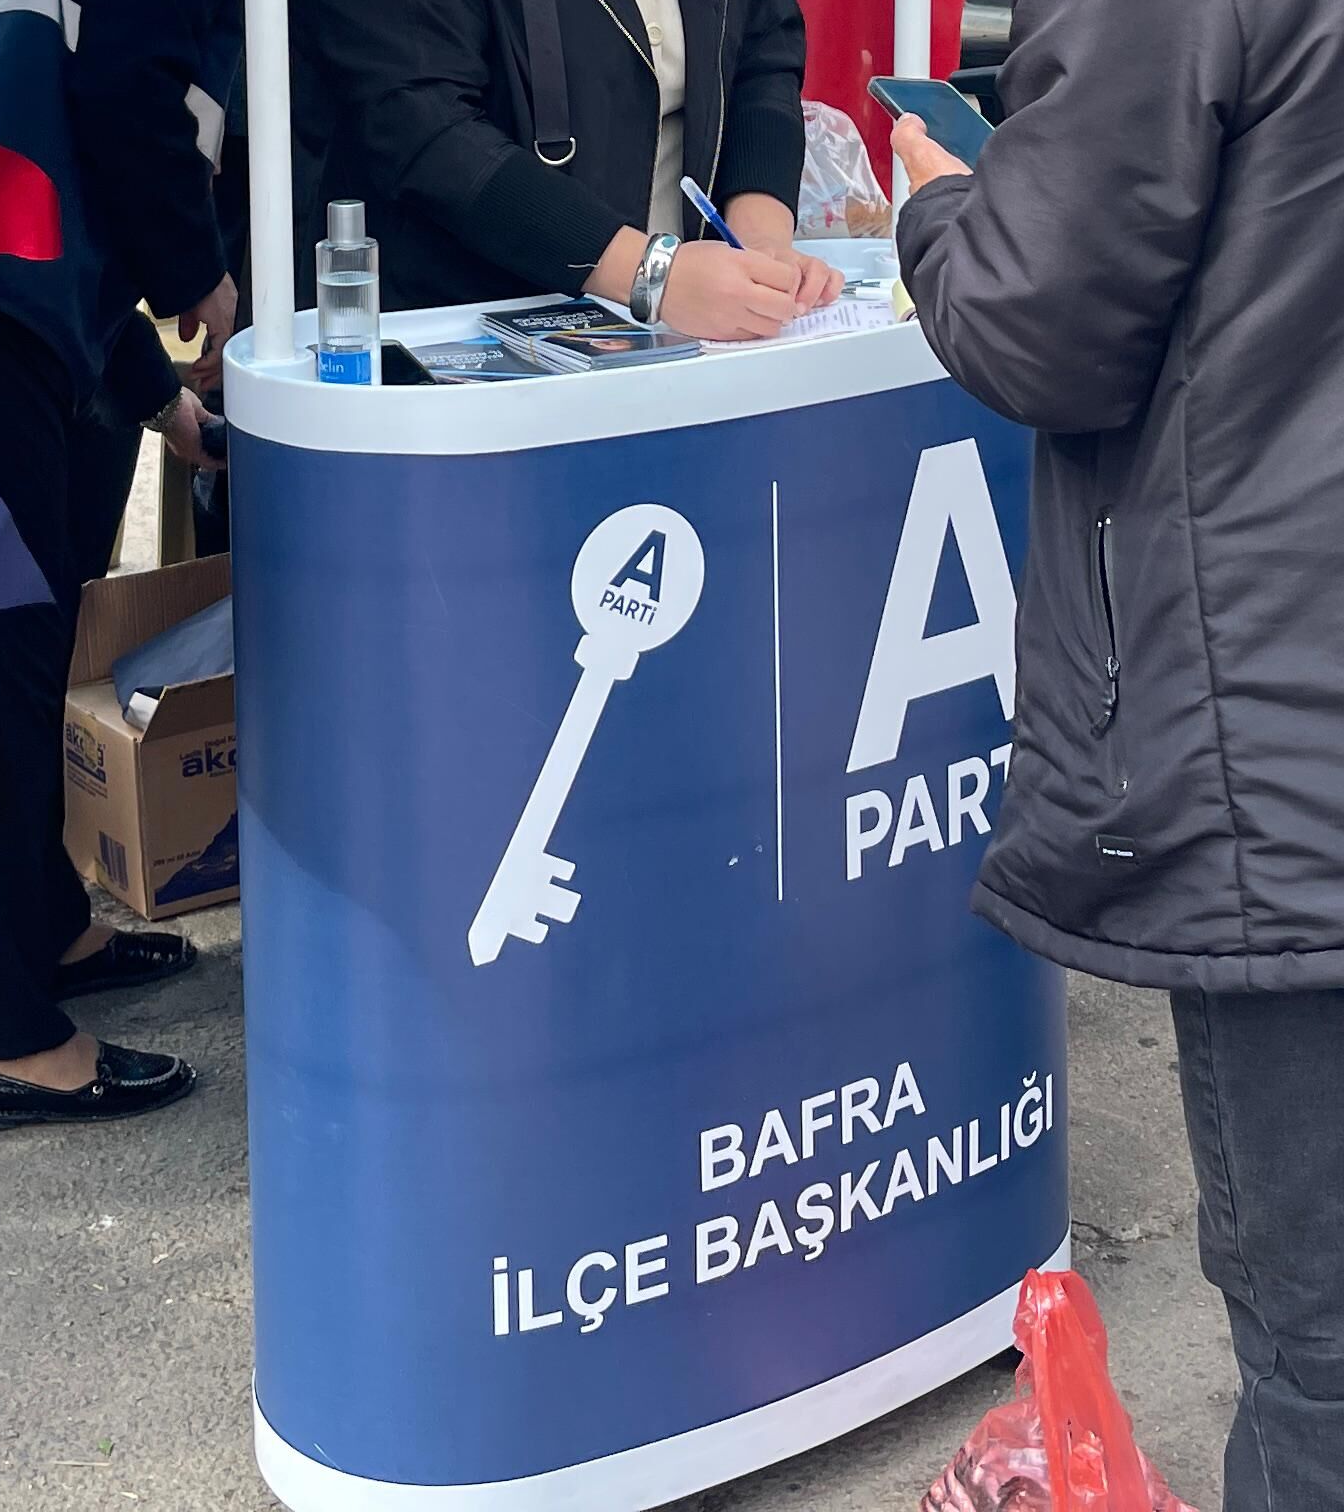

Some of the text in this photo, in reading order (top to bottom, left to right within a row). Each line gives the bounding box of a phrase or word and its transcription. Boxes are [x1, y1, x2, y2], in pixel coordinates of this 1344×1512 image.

[609, 529, 667, 602] A
[845, 437, 1018, 773] A
[493, 1071, 1055, 1336] İLÇE BAŞKANLIĞI
[698, 1062, 925, 1193] BAFRA
